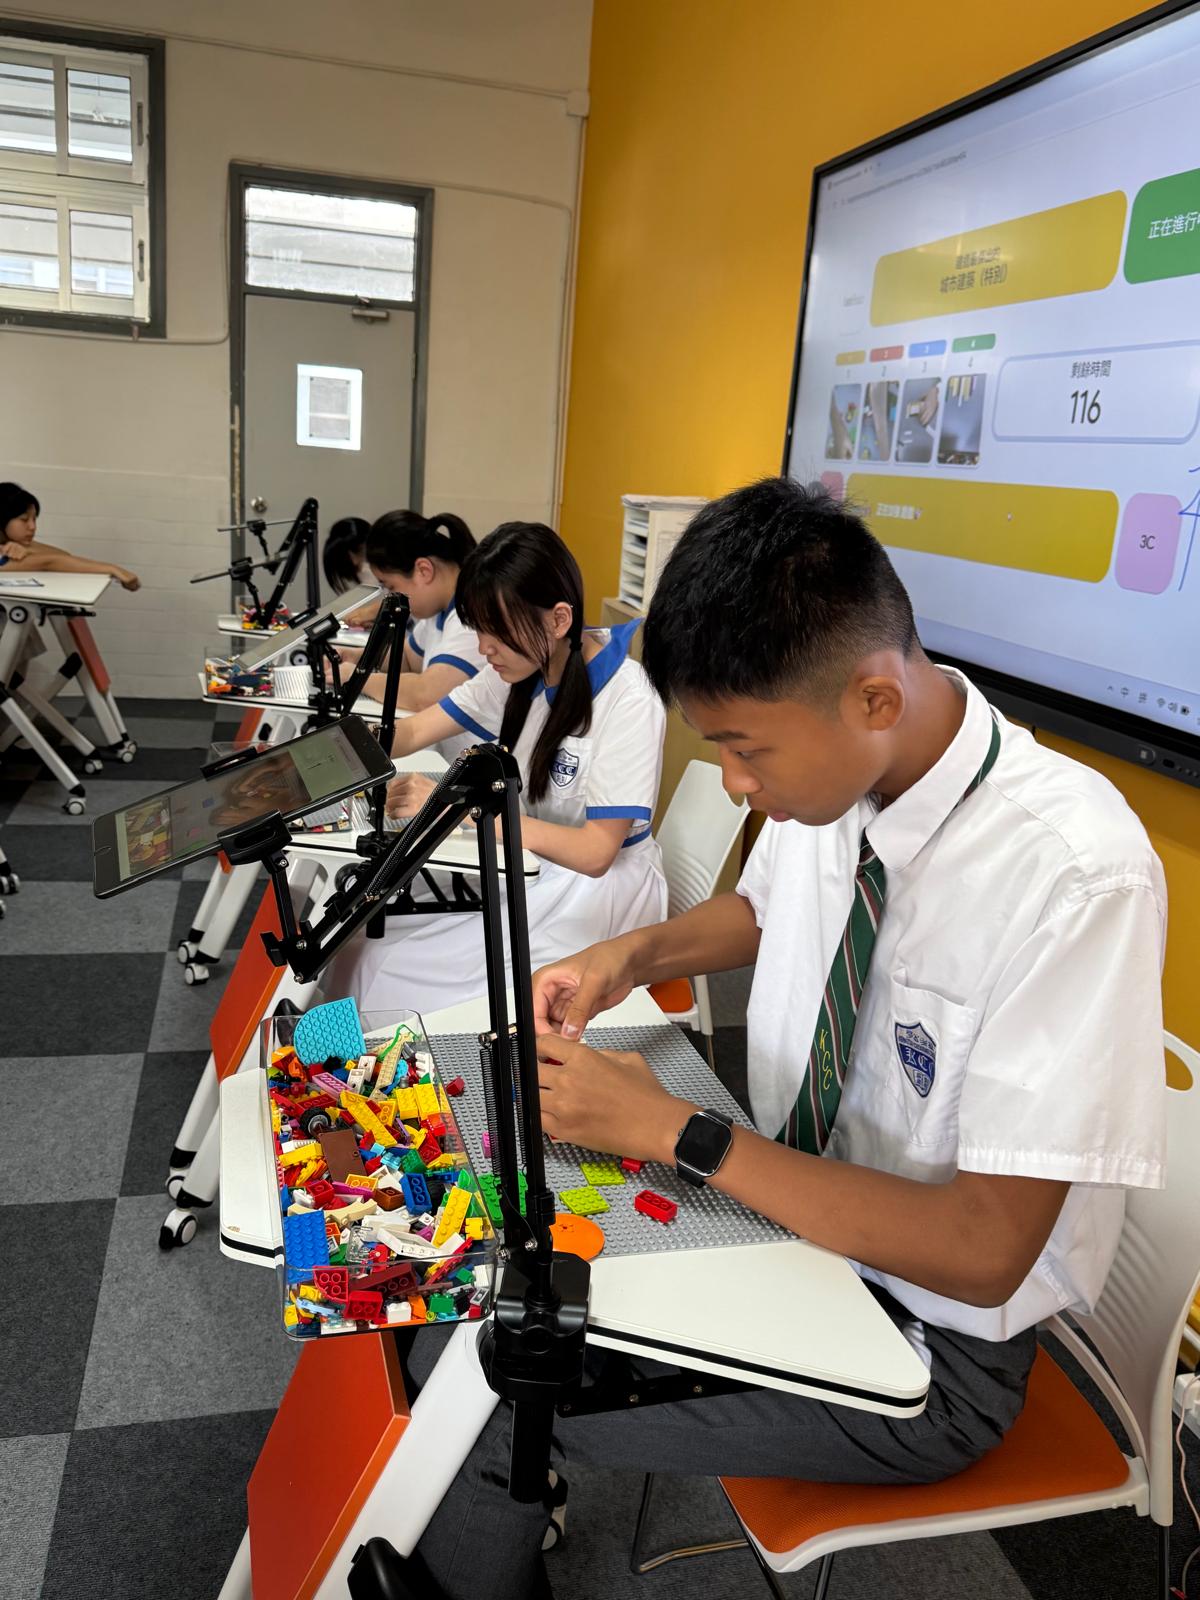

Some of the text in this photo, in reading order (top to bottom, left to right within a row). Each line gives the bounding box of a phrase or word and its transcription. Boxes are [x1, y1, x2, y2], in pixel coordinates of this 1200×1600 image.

[1071, 360, 1112, 379] 剩餘時間
[1071, 389, 1101, 424] 116
[1140, 534, 1156, 550] 3C
[819, 1028, 833, 1091] KCC
